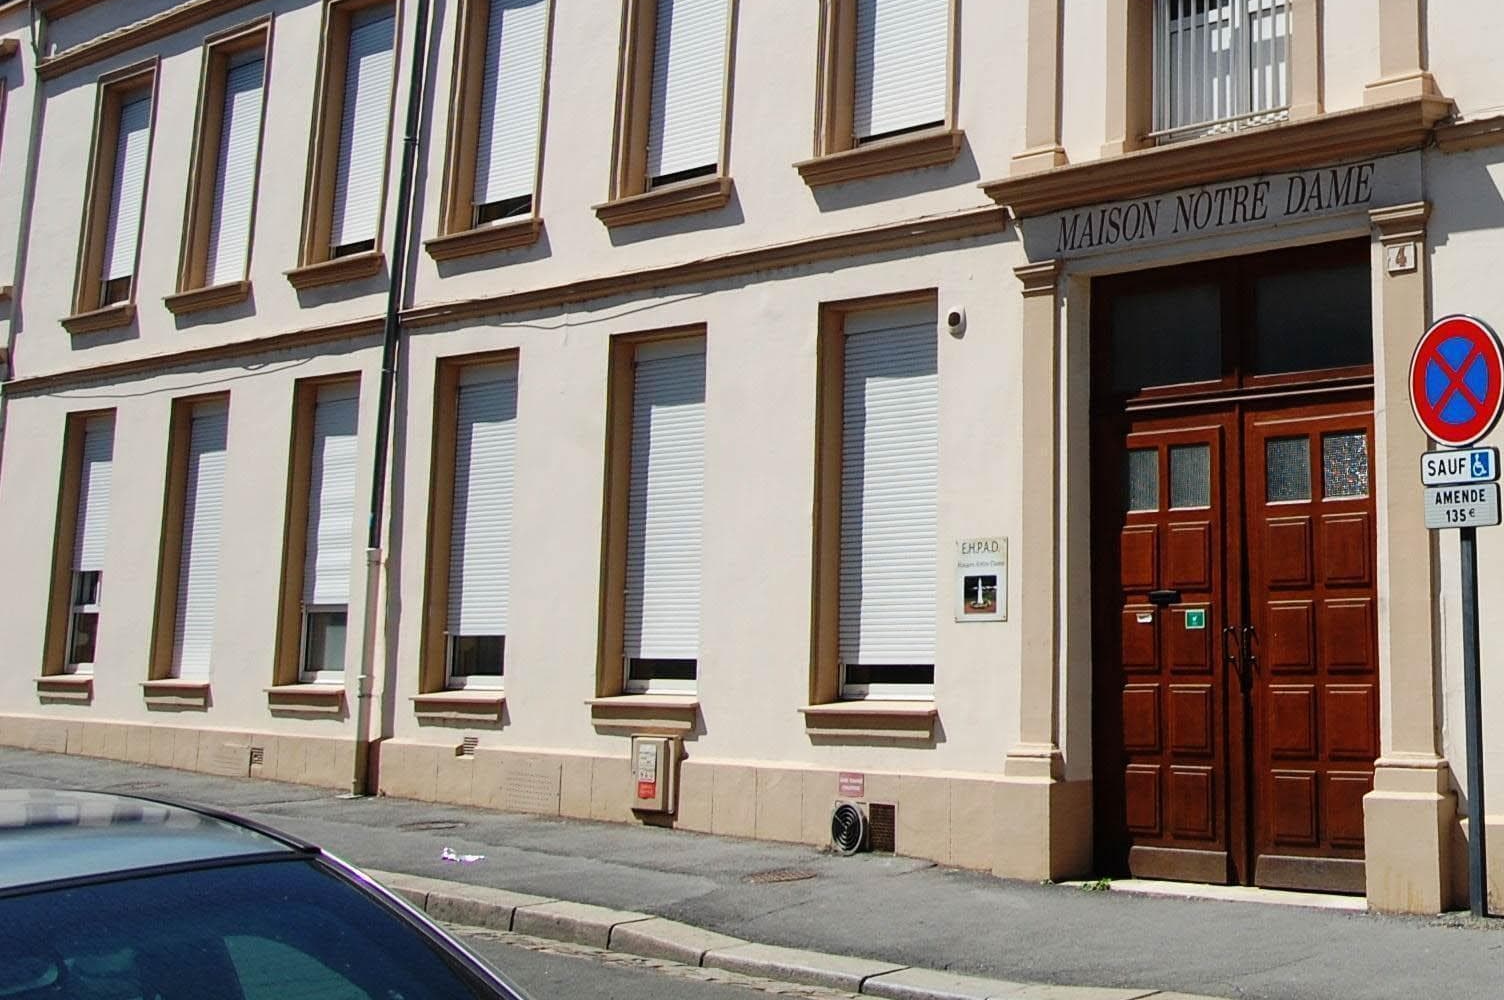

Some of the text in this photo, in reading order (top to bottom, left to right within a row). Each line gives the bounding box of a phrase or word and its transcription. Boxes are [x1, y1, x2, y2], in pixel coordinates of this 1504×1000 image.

[1057, 163, 1375, 252] MAISON NOTRE DAME
[1396, 246, 1407, 267] 4
[1427, 457, 1467, 477] SAUF
[1435, 488, 1486, 505] AMENDE
